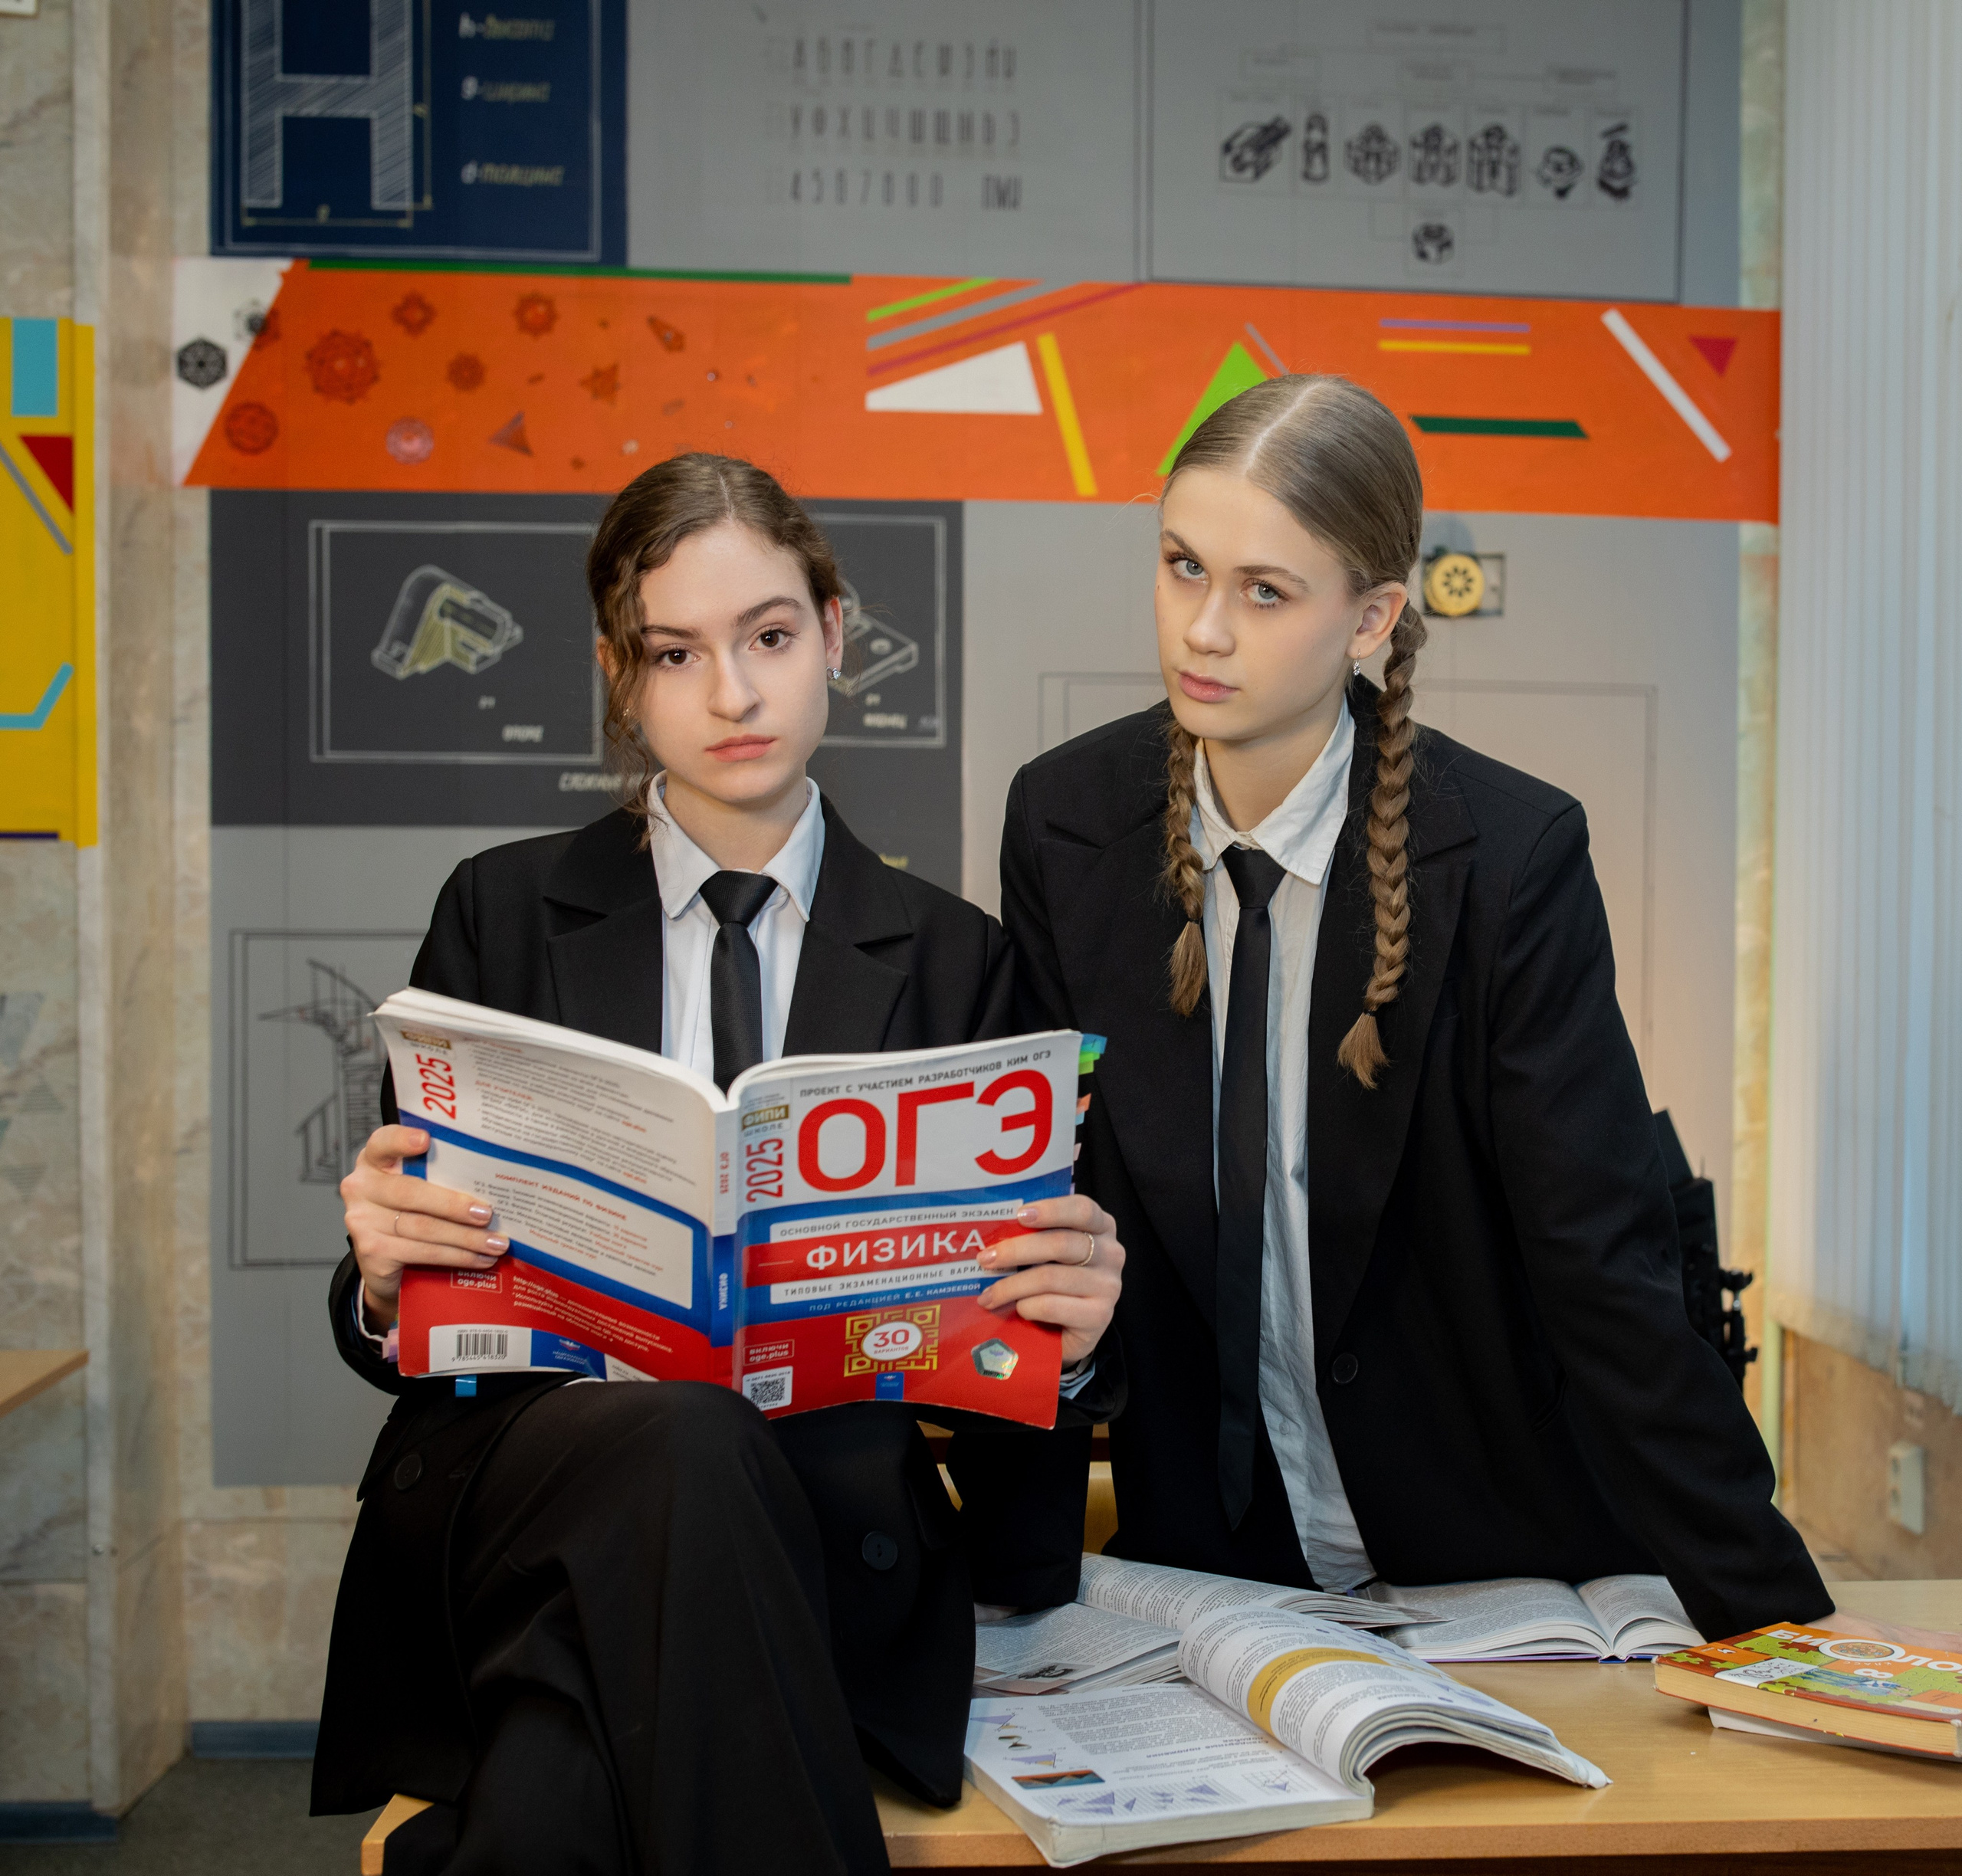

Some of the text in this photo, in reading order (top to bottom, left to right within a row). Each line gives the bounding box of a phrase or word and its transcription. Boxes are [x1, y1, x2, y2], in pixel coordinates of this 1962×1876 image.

[415, 1053, 456, 1120] 2025
[799, 1085, 841, 1097] ПРОЕКТ
[858, 1077, 913, 1092] УЧАСТИЕМ
[918, 1061, 1002, 1084] РАЗРАБОТЧИКОВ
[1006, 1056, 1028, 1068] КИМ
[1032, 1050, 1052, 1061] ОГЭ
[743, 1107, 786, 1127] ФИПИ
[743, 1122, 783, 1138] ШКОЛЕ
[798, 1069, 1054, 1193] ОГЭ
[746, 1138, 784, 1203] 2025
[780, 1208, 1014, 1237] ОСНОВНОЙ ГОСУДАРСТВЕННЫЙ ЭКЗАМЕН
[806, 1229, 986, 1271] ФИЗИКА
[458, 1278, 497, 1289] oge.plus
[718, 1272, 729, 1310] ФИЗИКА
[784, 1284, 833, 1297] ТИПОВЫЕ
[839, 1270, 943, 1290] ЭКЗАМЕНАЦИОННЫЕ
[809, 1303, 831, 1311] ПОД
[836, 1294, 901, 1308] РЕДАКЦИЕЙ
[927, 1283, 981, 1296] КАМЗЕЕВОЙ
[750, 1343, 789, 1356] включи
[873, 1329, 910, 1348] 30
[874, 1346, 910, 1355] ВАРИАНТОВ
[750, 1350, 789, 1363] oge.plus
[1766, 1628, 1962, 1674] БИОЛО
[1853, 1668, 1895, 1679] 8
